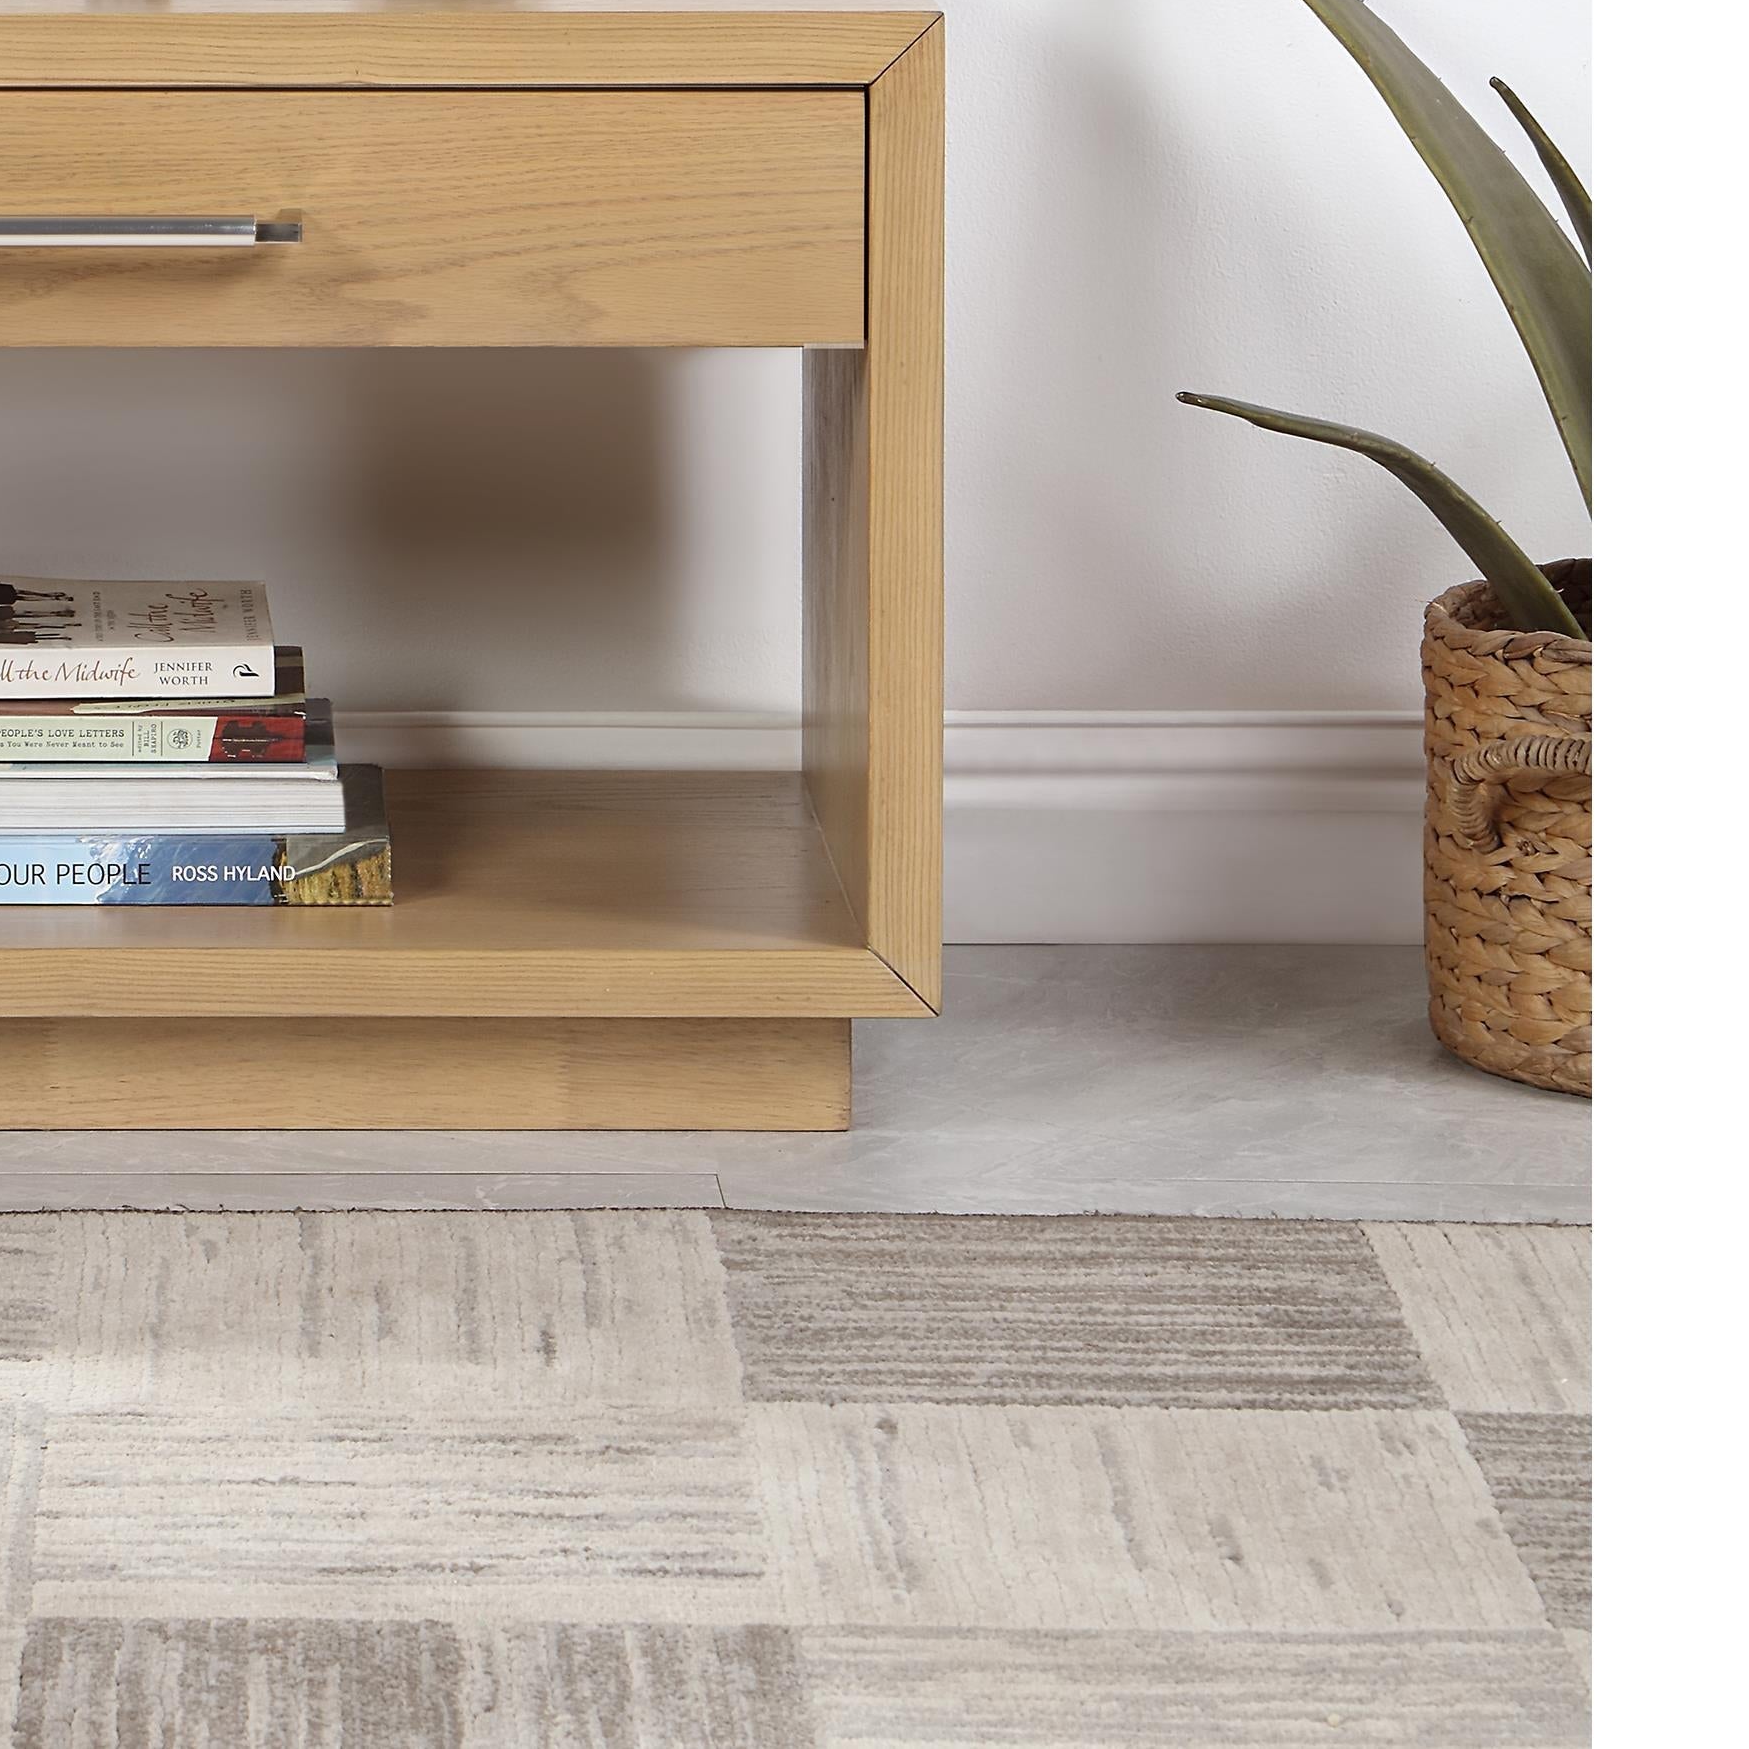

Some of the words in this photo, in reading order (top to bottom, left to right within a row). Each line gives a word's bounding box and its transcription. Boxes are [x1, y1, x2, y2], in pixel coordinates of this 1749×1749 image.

[15, 659, 52, 682] the
[54, 657, 141, 686] Midwife
[154, 662, 213, 673] JENNIFER
[159, 676, 209, 686] WORTH
[48, 729, 75, 738] LOVE
[79, 729, 125, 738] LETTERS
[57, 862, 152, 885] PEOPLE
[172, 865, 218, 882] ROSS
[223, 865, 297, 882] HYLAND
